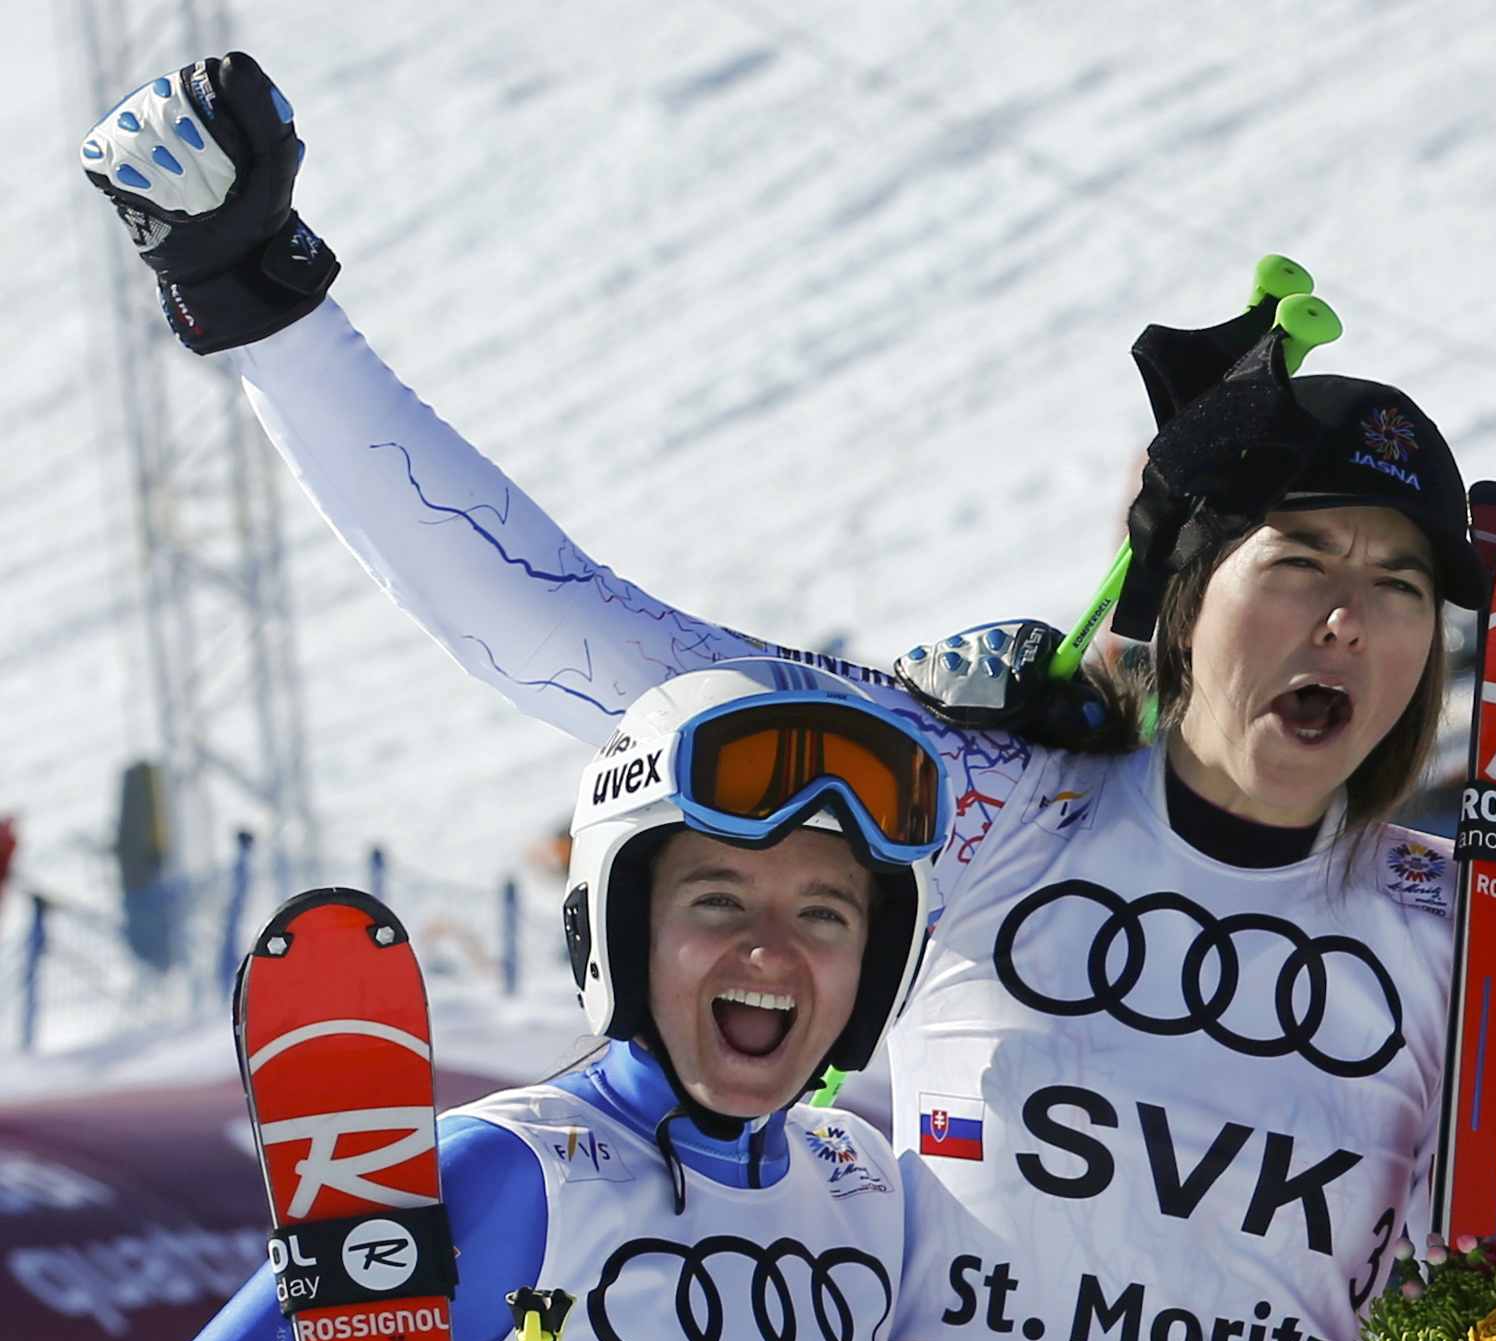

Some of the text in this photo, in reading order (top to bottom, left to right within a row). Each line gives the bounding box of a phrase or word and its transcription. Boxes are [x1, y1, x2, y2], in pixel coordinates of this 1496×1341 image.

[592, 748, 664, 806] uvex
[1015, 1085, 1363, 1257] SVK
[276, 1275, 320, 1303] day
[942, 1253, 1046, 1341] St.
